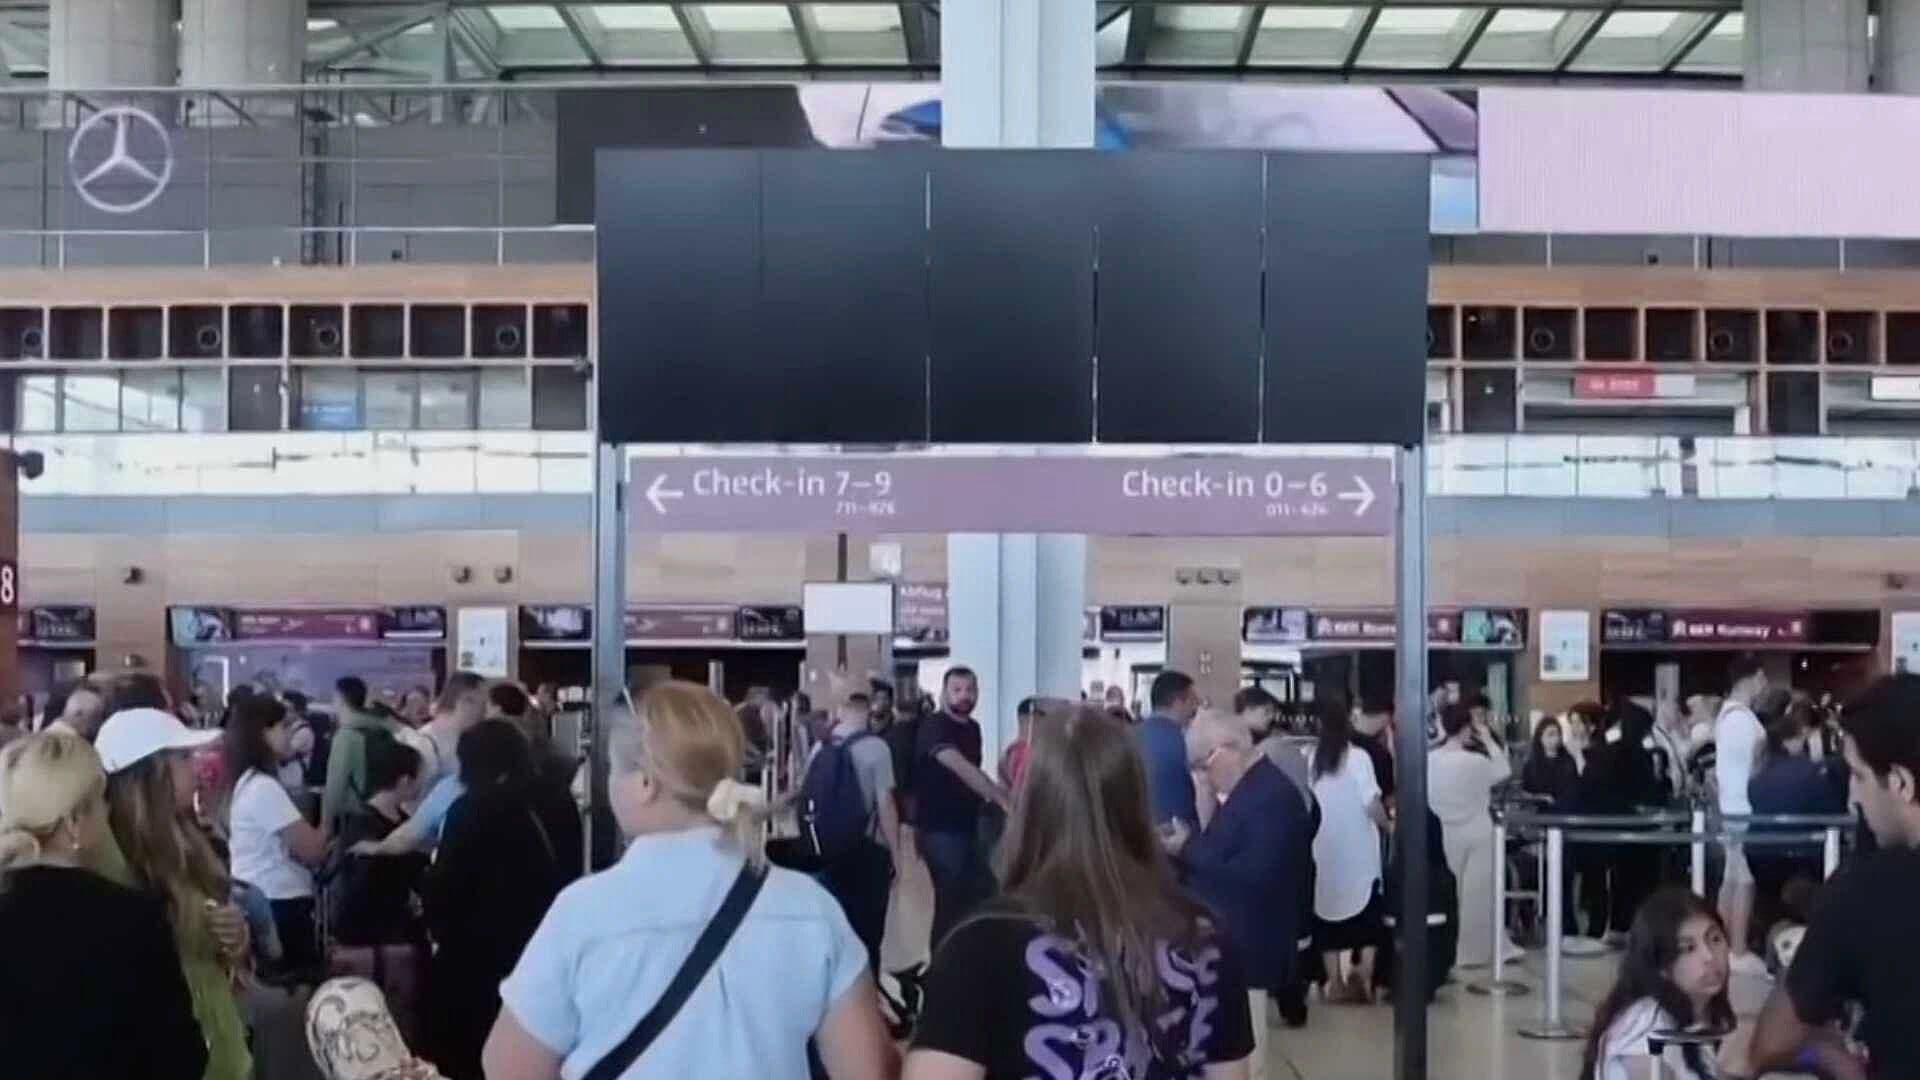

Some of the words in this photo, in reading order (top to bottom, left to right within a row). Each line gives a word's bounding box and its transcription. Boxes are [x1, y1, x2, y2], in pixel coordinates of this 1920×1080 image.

[693, 468, 825, 497] Check-in
[835, 470, 892, 496] 7–9
[1122, 469, 1254, 498] Check-in
[1265, 470, 1328, 498] 0–6
[0, 565, 14, 604] 8
